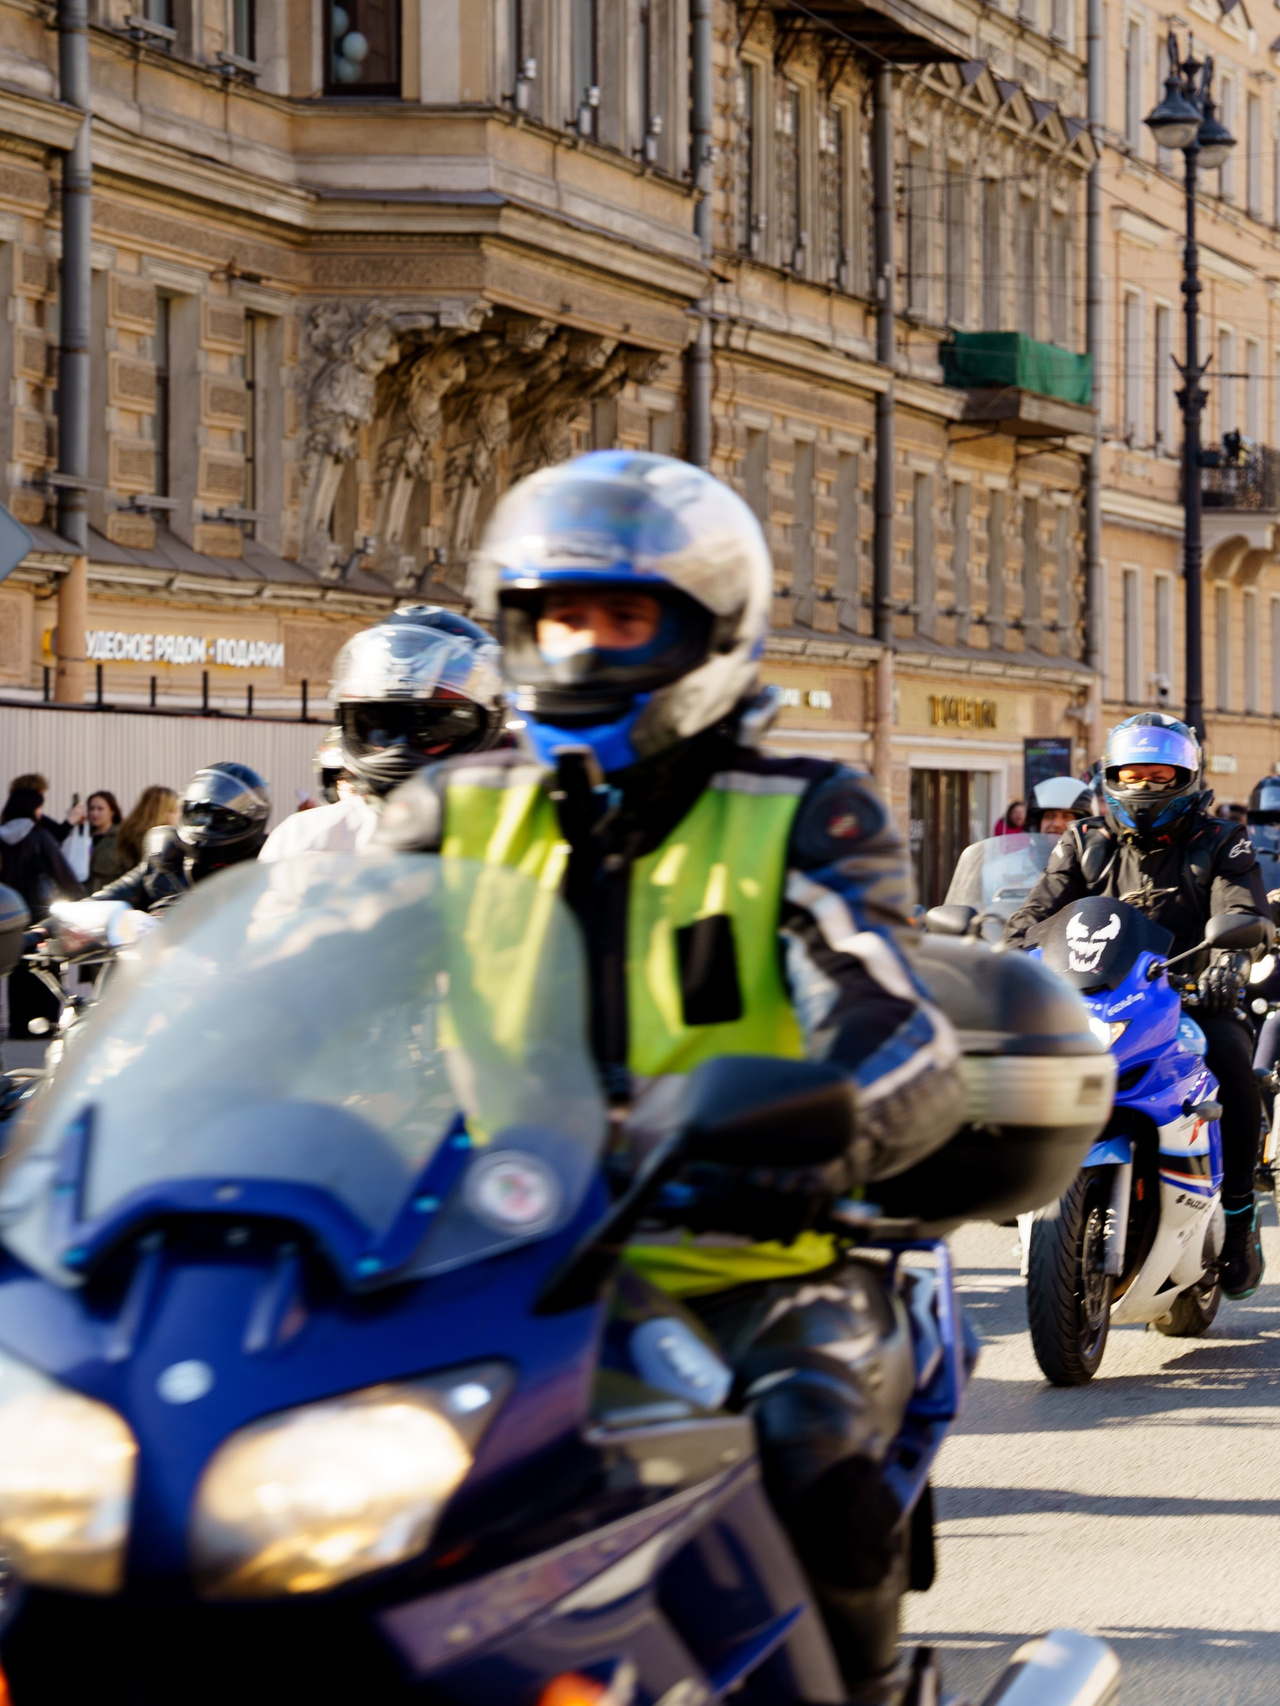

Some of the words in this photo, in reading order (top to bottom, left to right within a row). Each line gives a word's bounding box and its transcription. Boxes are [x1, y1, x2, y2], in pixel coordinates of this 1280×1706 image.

[85, 630, 154, 662] УДЕСНОЕ
[155, 634, 207, 665] РЯДОМ
[216, 637, 284, 668] ПОДАРКИ
